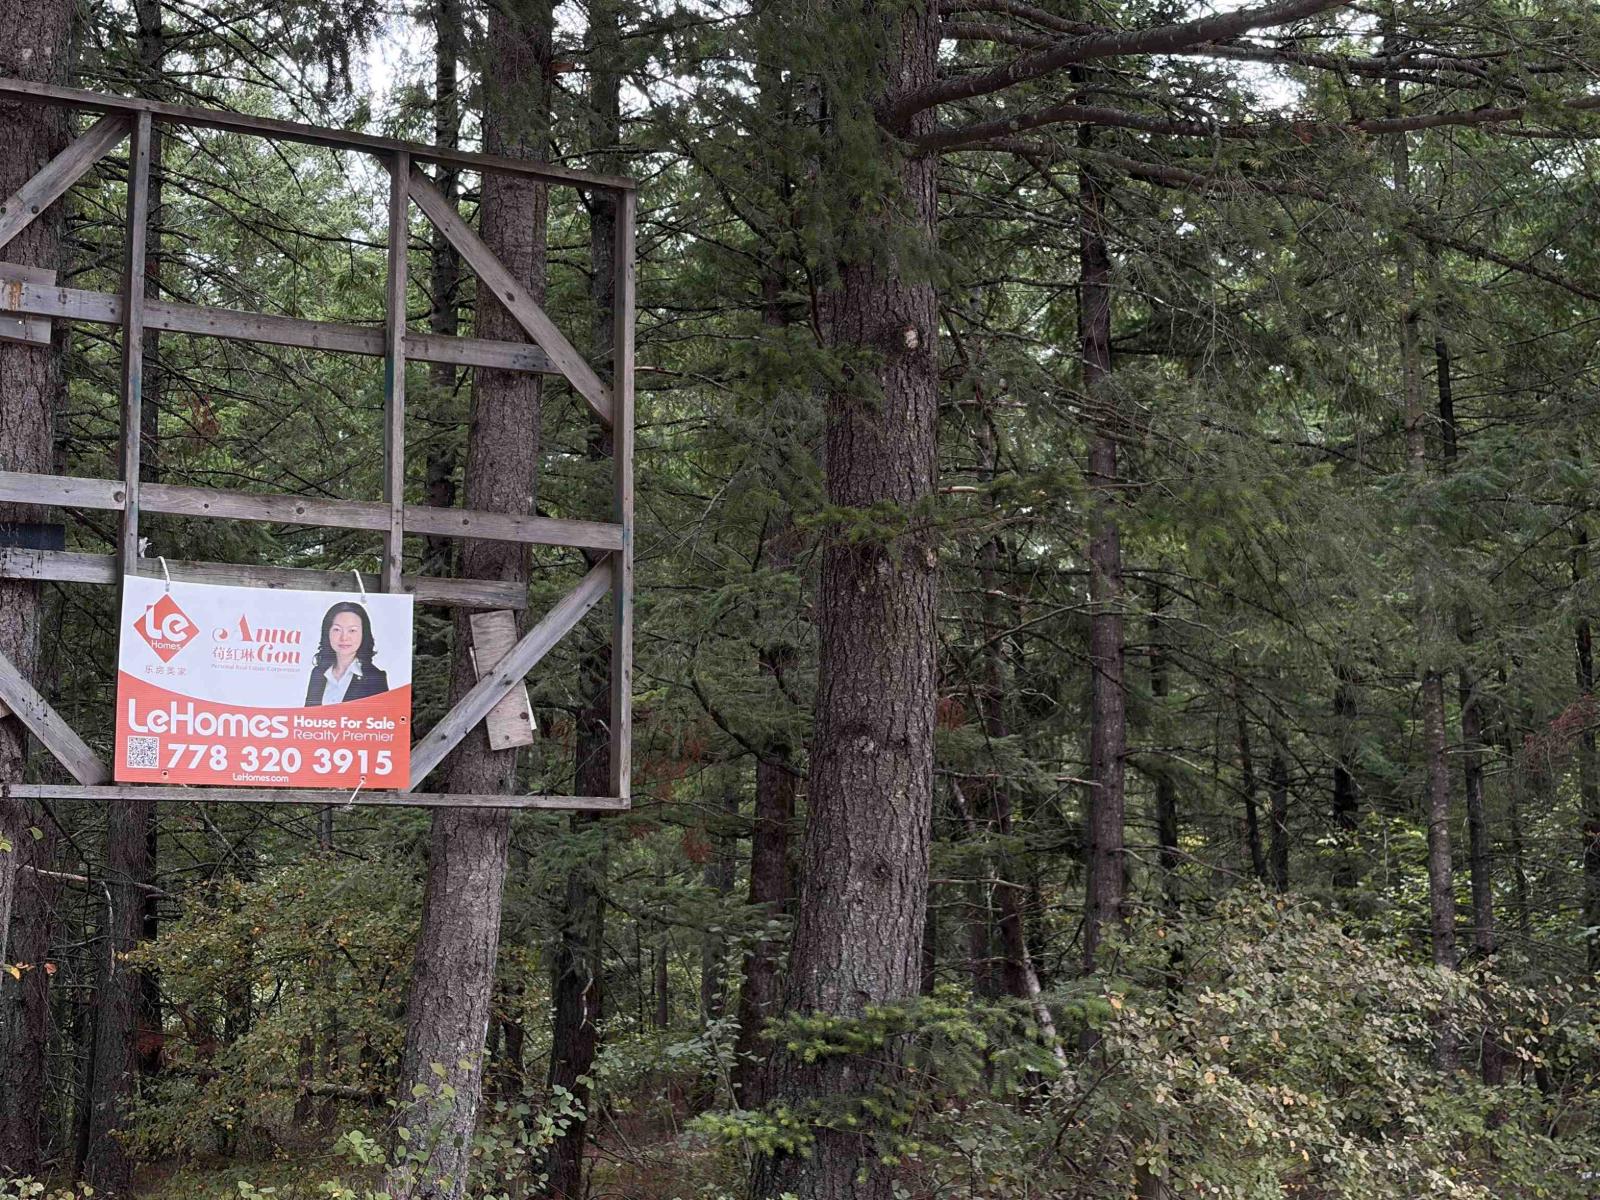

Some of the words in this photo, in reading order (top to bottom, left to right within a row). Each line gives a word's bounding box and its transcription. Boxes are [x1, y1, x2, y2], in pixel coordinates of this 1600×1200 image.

[212, 614, 301, 645] Anna
[151, 639, 181, 650] Homes
[257, 643, 301, 665] Gou
[128, 699, 289, 739] LeHomes
[293, 715, 337, 729] House
[340, 716, 363, 730] For
[366, 716, 395, 730] Sale
[293, 729, 339, 743] Realty
[343, 730, 394, 742] Premier
[167, 743, 228, 771] 778
[240, 745, 302, 773] 320
[313, 748, 393, 775] 3915
[232, 772, 289, 783] LeHomes.com
